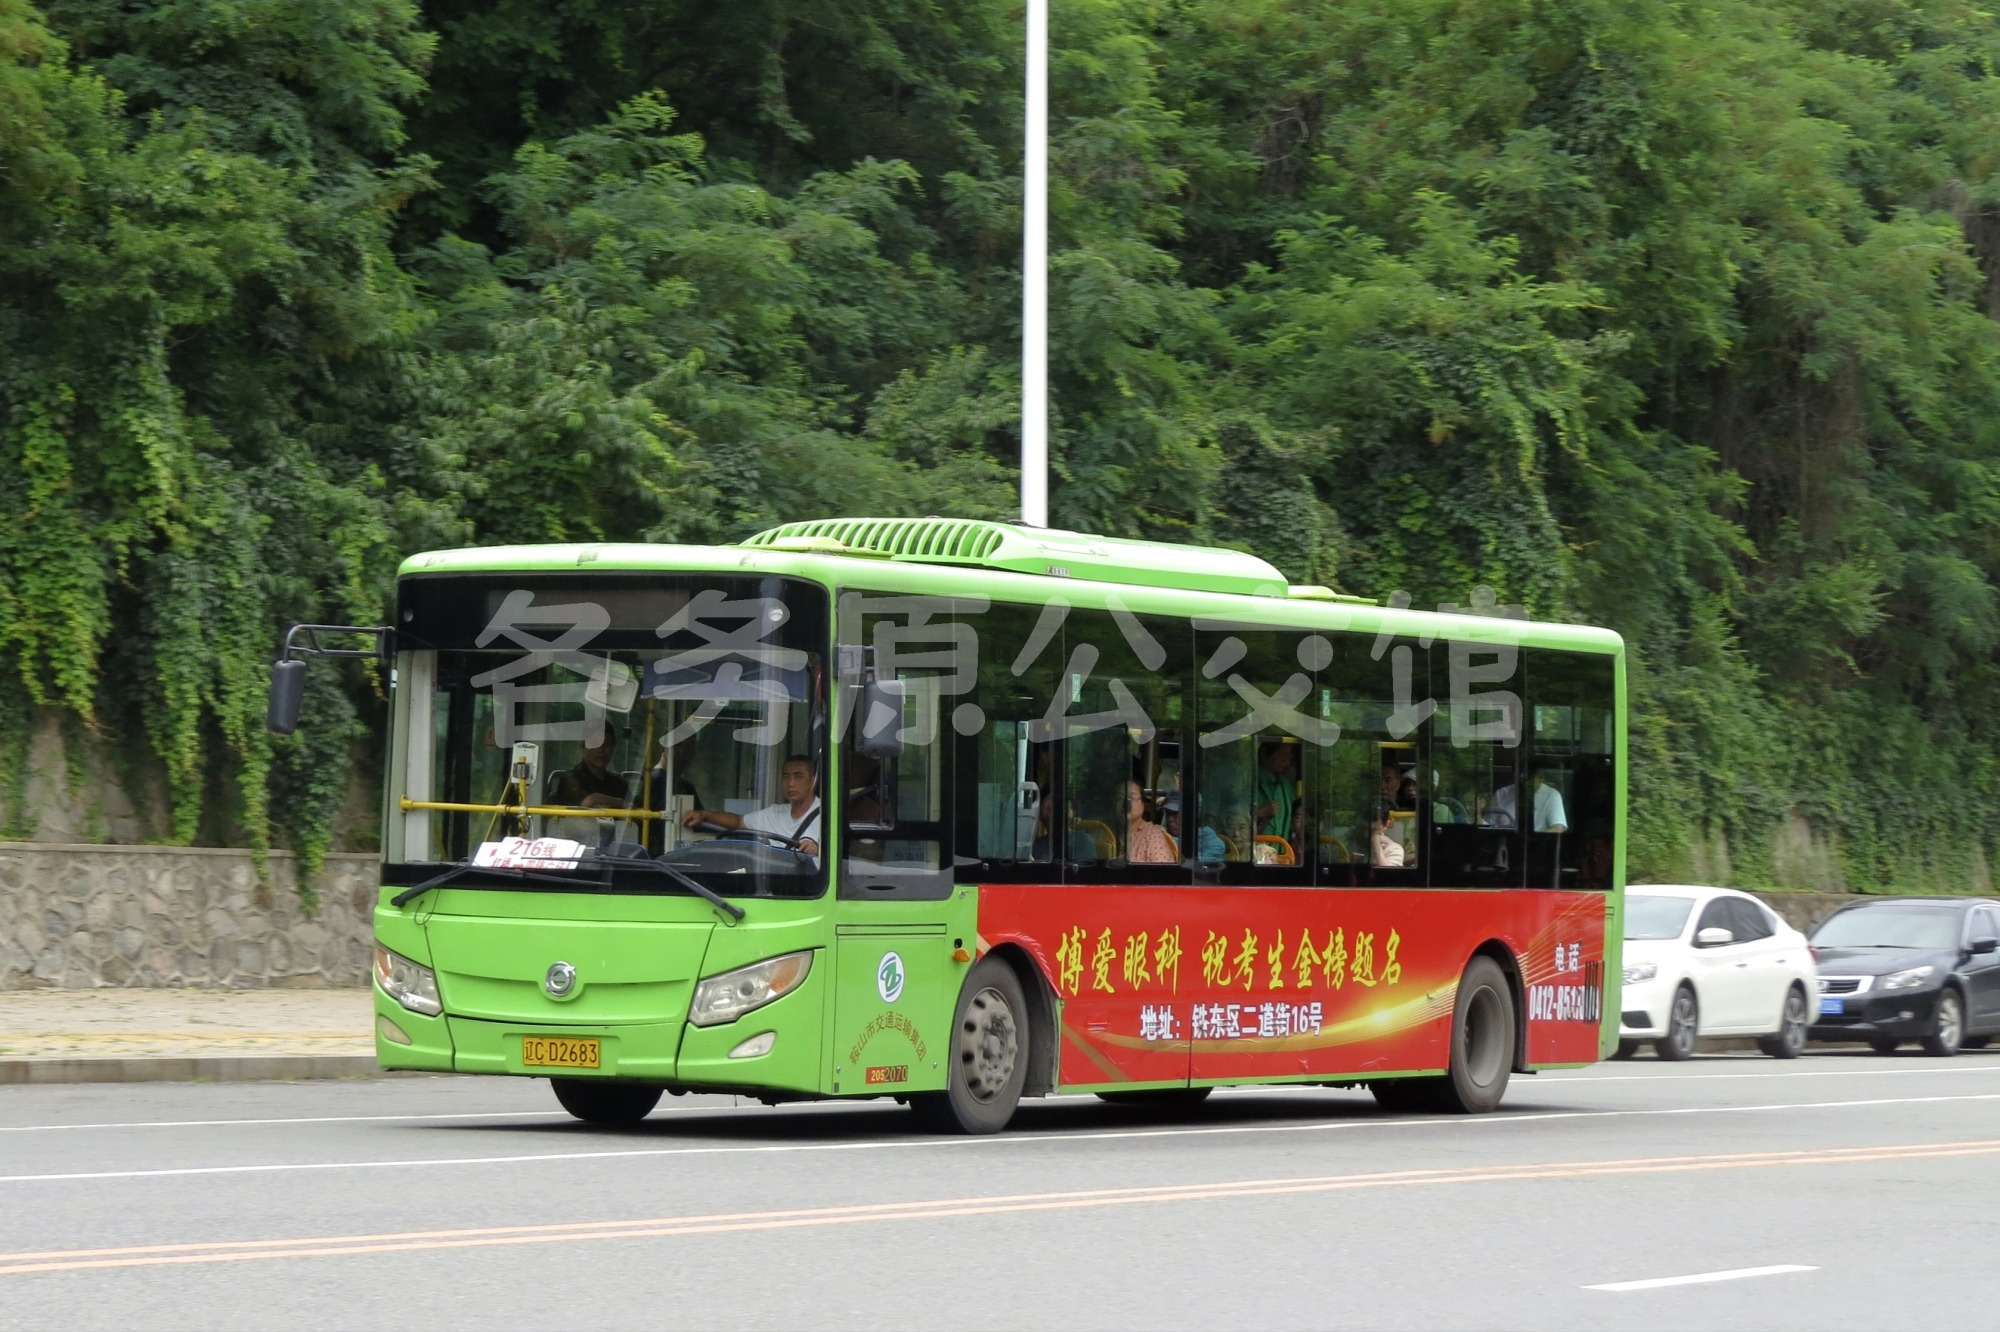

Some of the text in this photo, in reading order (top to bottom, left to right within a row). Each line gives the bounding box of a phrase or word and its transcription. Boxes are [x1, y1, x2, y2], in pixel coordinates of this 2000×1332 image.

[509, 840, 557, 857] 216线
[1055, 925, 1402, 996] 博爱眼科 祝考生金榜题名
[1555, 942, 1580, 972] 电话
[849, 1010, 927, 1064] 鞍山市交通运输集团
[1191, 1002, 1324, 1039] 铁东区二道街16号
